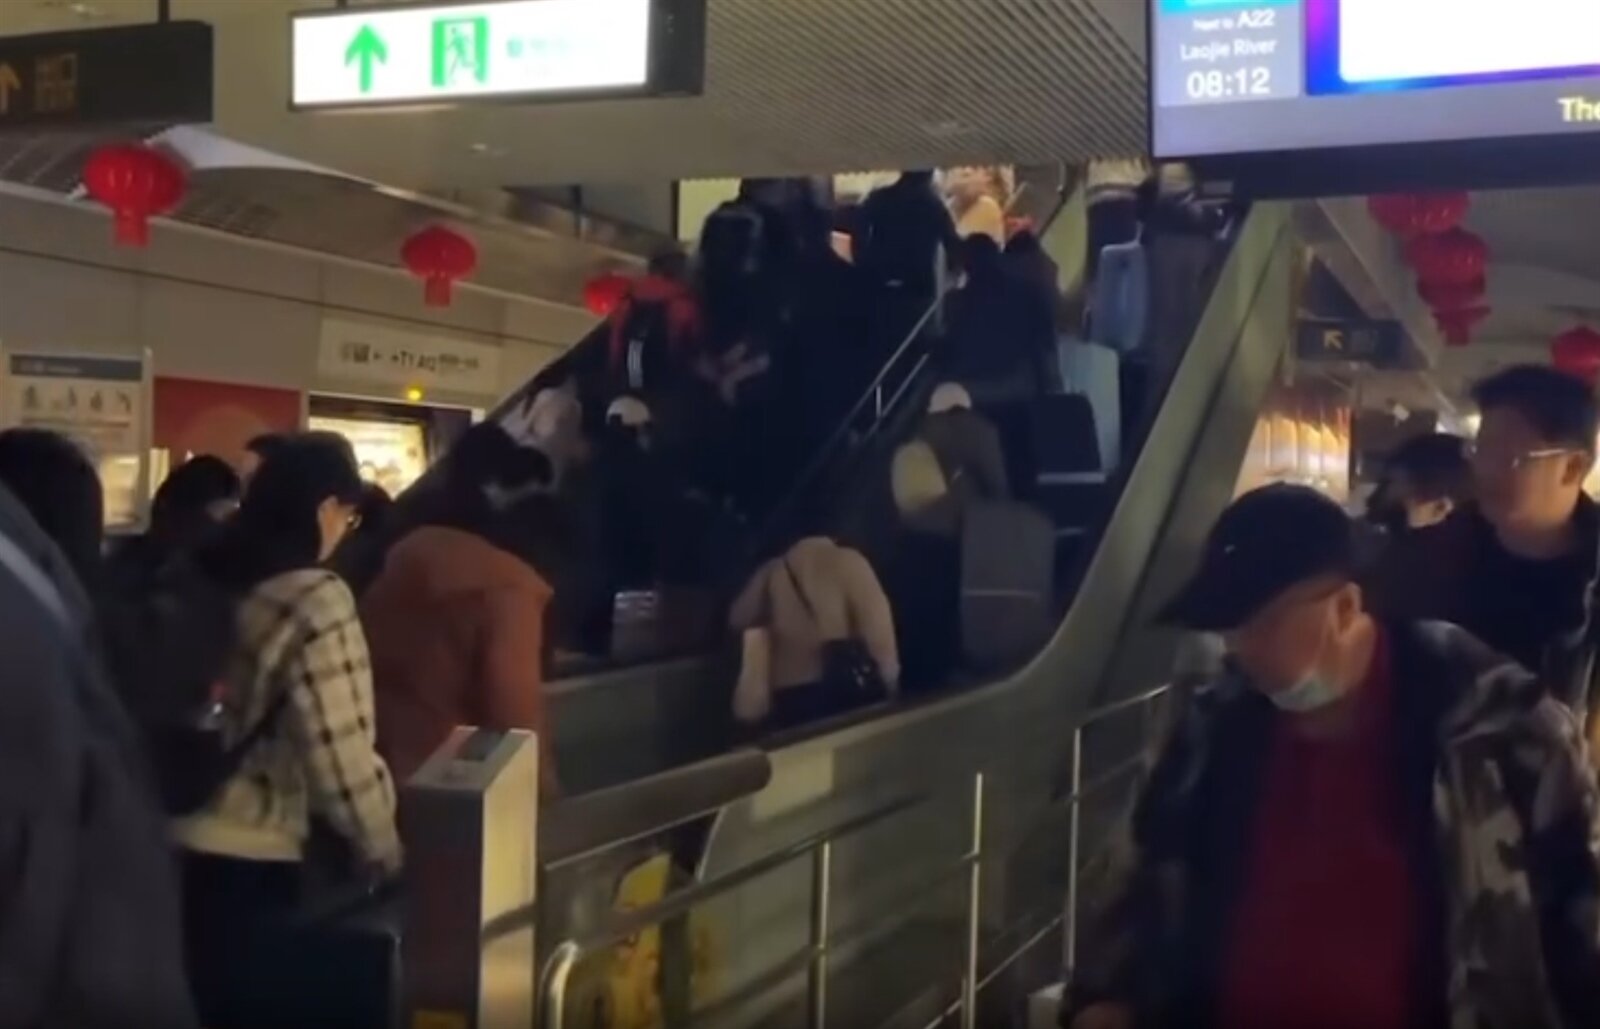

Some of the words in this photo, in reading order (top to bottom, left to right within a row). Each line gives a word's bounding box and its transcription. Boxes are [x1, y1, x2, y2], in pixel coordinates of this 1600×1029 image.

[1237, 8, 1276, 29] A22
[1180, 42, 1230, 62] Laojie
[1234, 38, 1278, 56] River
[1186, 66, 1271, 99] 08:12
